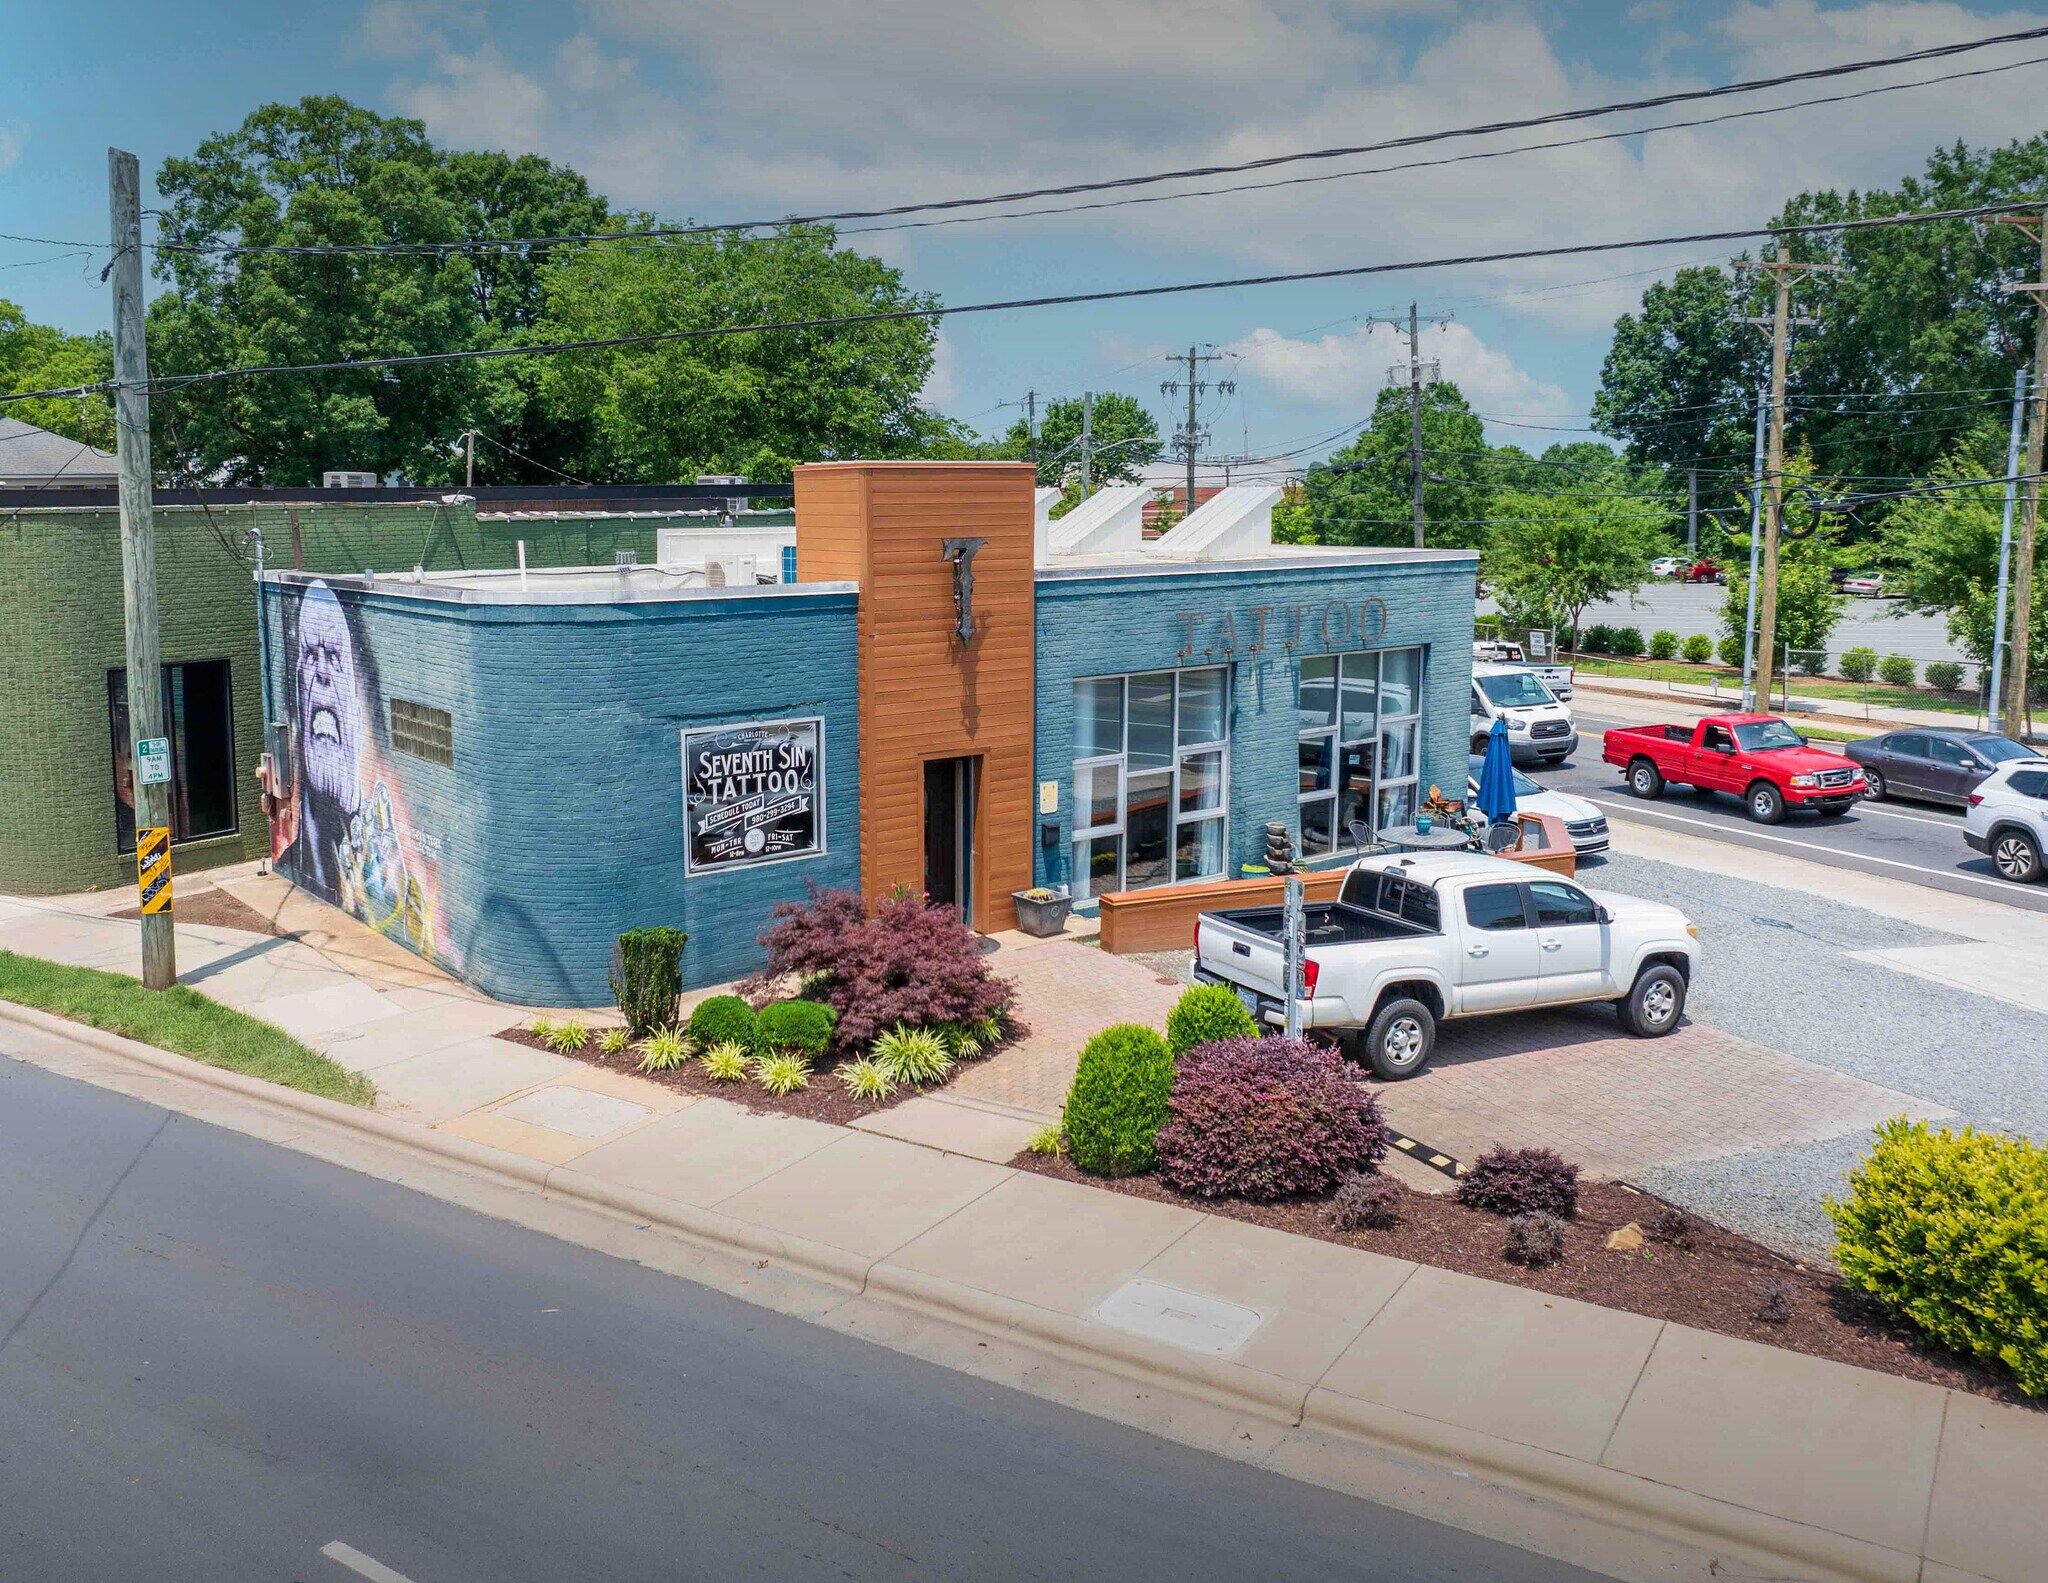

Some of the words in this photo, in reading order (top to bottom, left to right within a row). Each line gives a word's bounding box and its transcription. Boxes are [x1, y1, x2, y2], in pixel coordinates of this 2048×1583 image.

[1175, 597, 1389, 658] TATTOO
[142, 744, 148, 753] 2
[699, 750, 773, 779] SEVENTH
[778, 743, 806, 769] SIN
[707, 769, 799, 805] TATTOO
[709, 807, 740, 824] SCHEDULE
[741, 800, 760, 812] TODAY
[767, 833, 794, 841] FRI-SAT
